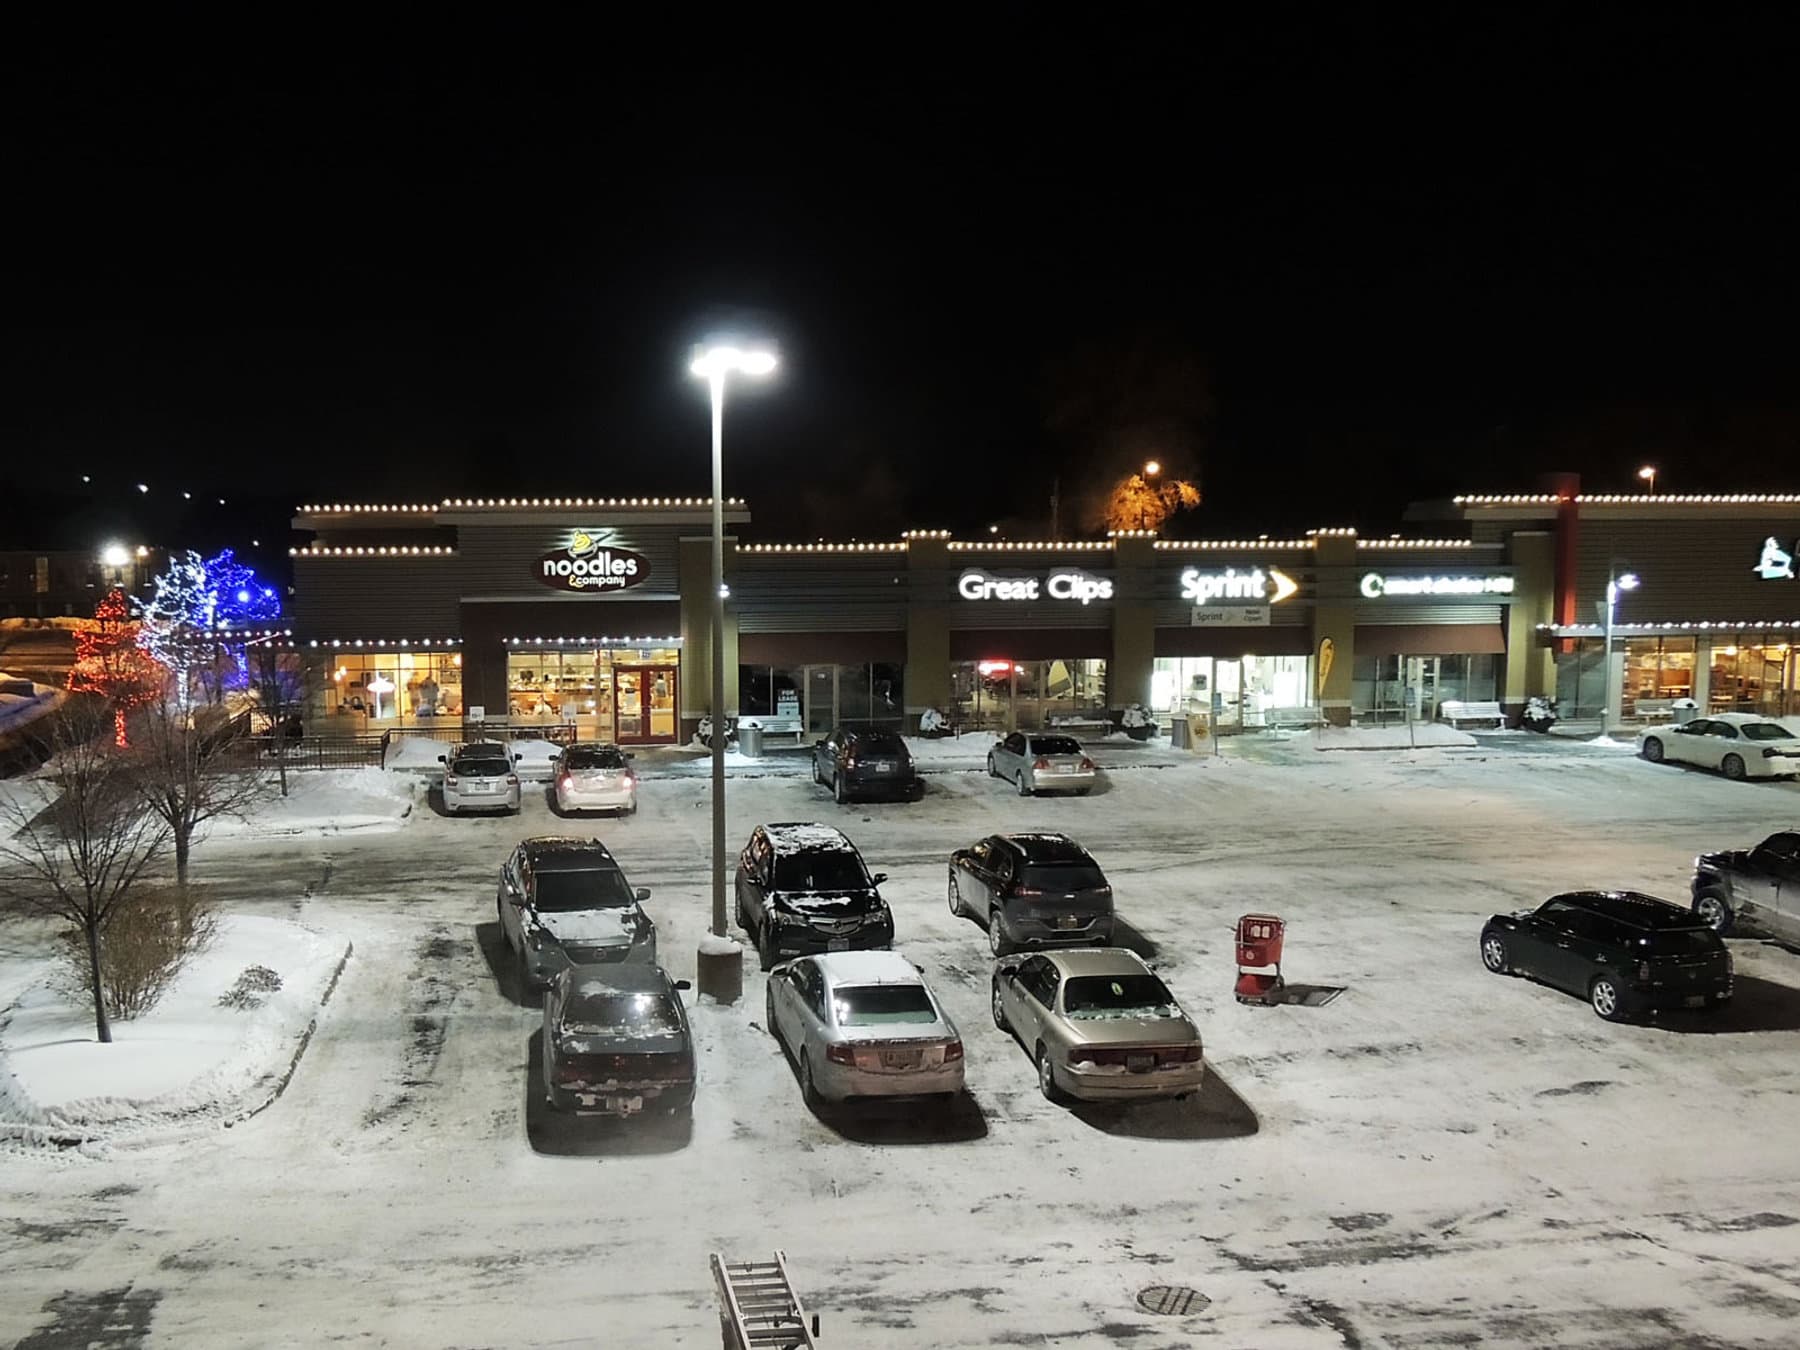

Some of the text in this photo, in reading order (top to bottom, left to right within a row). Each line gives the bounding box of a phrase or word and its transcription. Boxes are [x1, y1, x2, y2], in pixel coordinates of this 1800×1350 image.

[543, 551, 638, 576] noodles
[958, 573, 1114, 606] Great Clips
[1181, 569, 1266, 605] Sprint
[1197, 612, 1223, 622] Sprint
